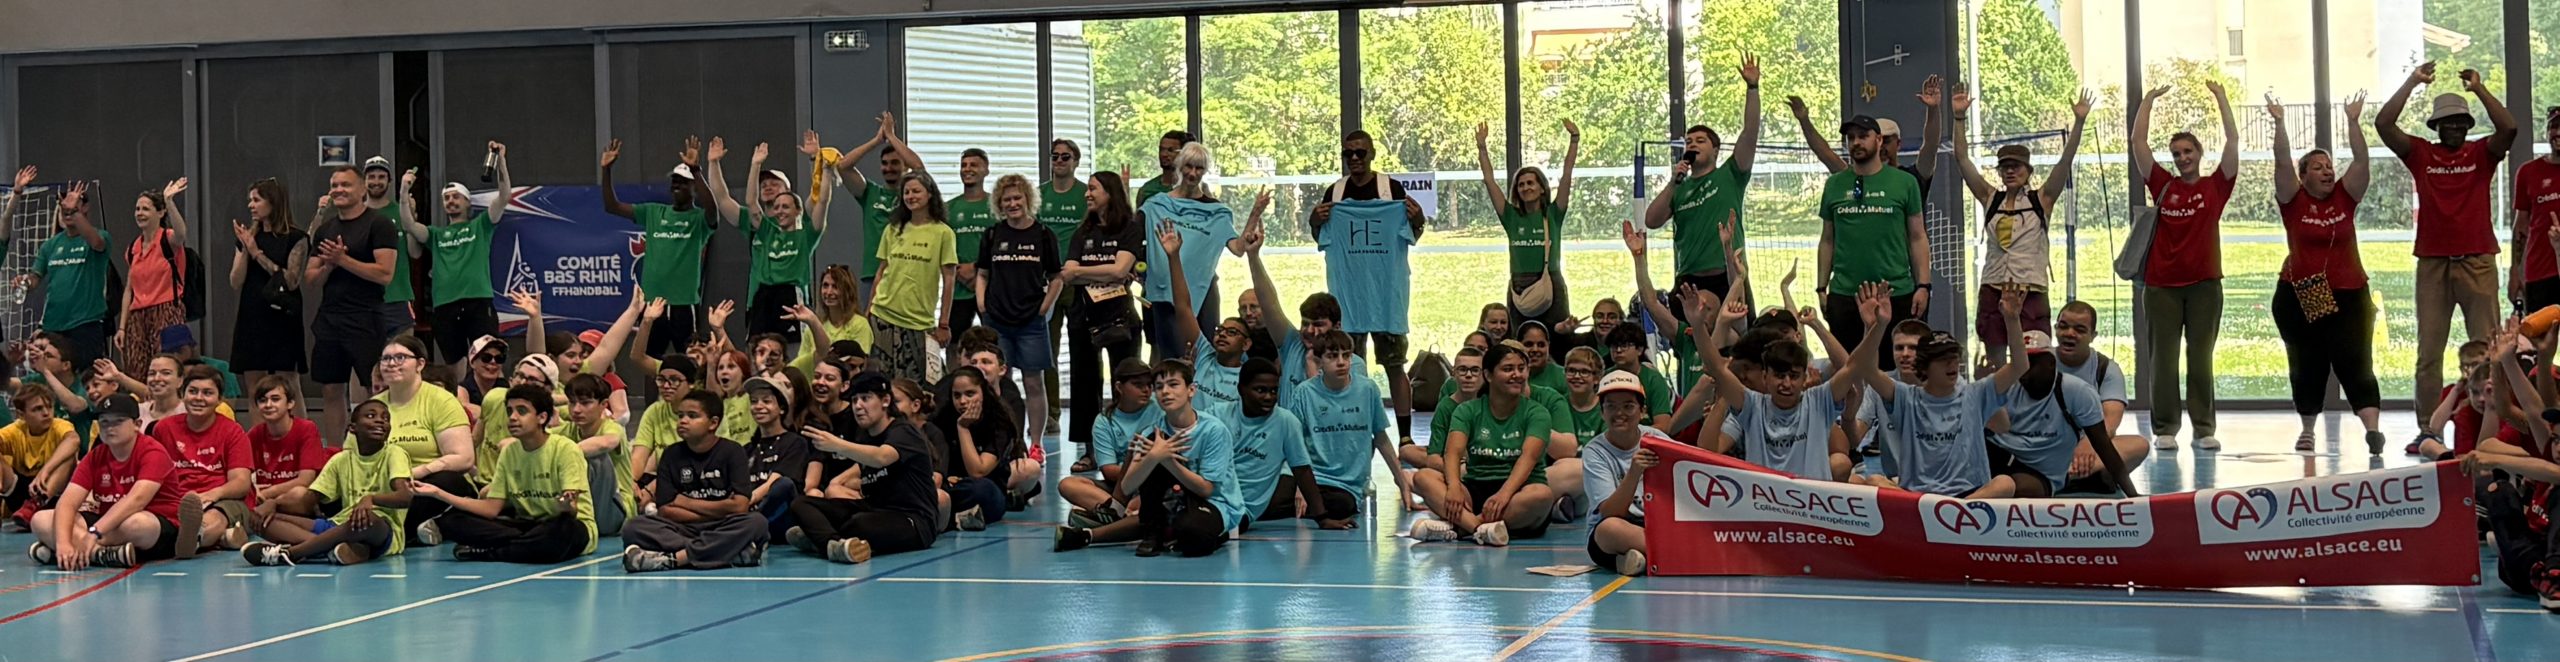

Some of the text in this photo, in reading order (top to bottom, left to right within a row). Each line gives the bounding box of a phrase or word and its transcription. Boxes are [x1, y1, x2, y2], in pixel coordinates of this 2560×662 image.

[1837, 206, 1894, 214] Crédit Mutuel
[557, 254, 621, 270] COMITÉ
[580, 270, 622, 284] RHIN
[1471, 447, 1493, 456] Crédit
[1752, 483, 1869, 518] ALSACE
[2287, 475, 2424, 515] ALSACE
[1810, 513, 1871, 530] européenne
[2006, 501, 2138, 528] ALSACE
[2287, 505, 2425, 528] Collectivité européenne
[1713, 527, 1855, 547] www.alsace.eu
[2007, 529, 2069, 539] Collectivité
[2245, 538, 2403, 561] www.alsace.eu
[1968, 551, 2118, 566] www.alsace.eu
